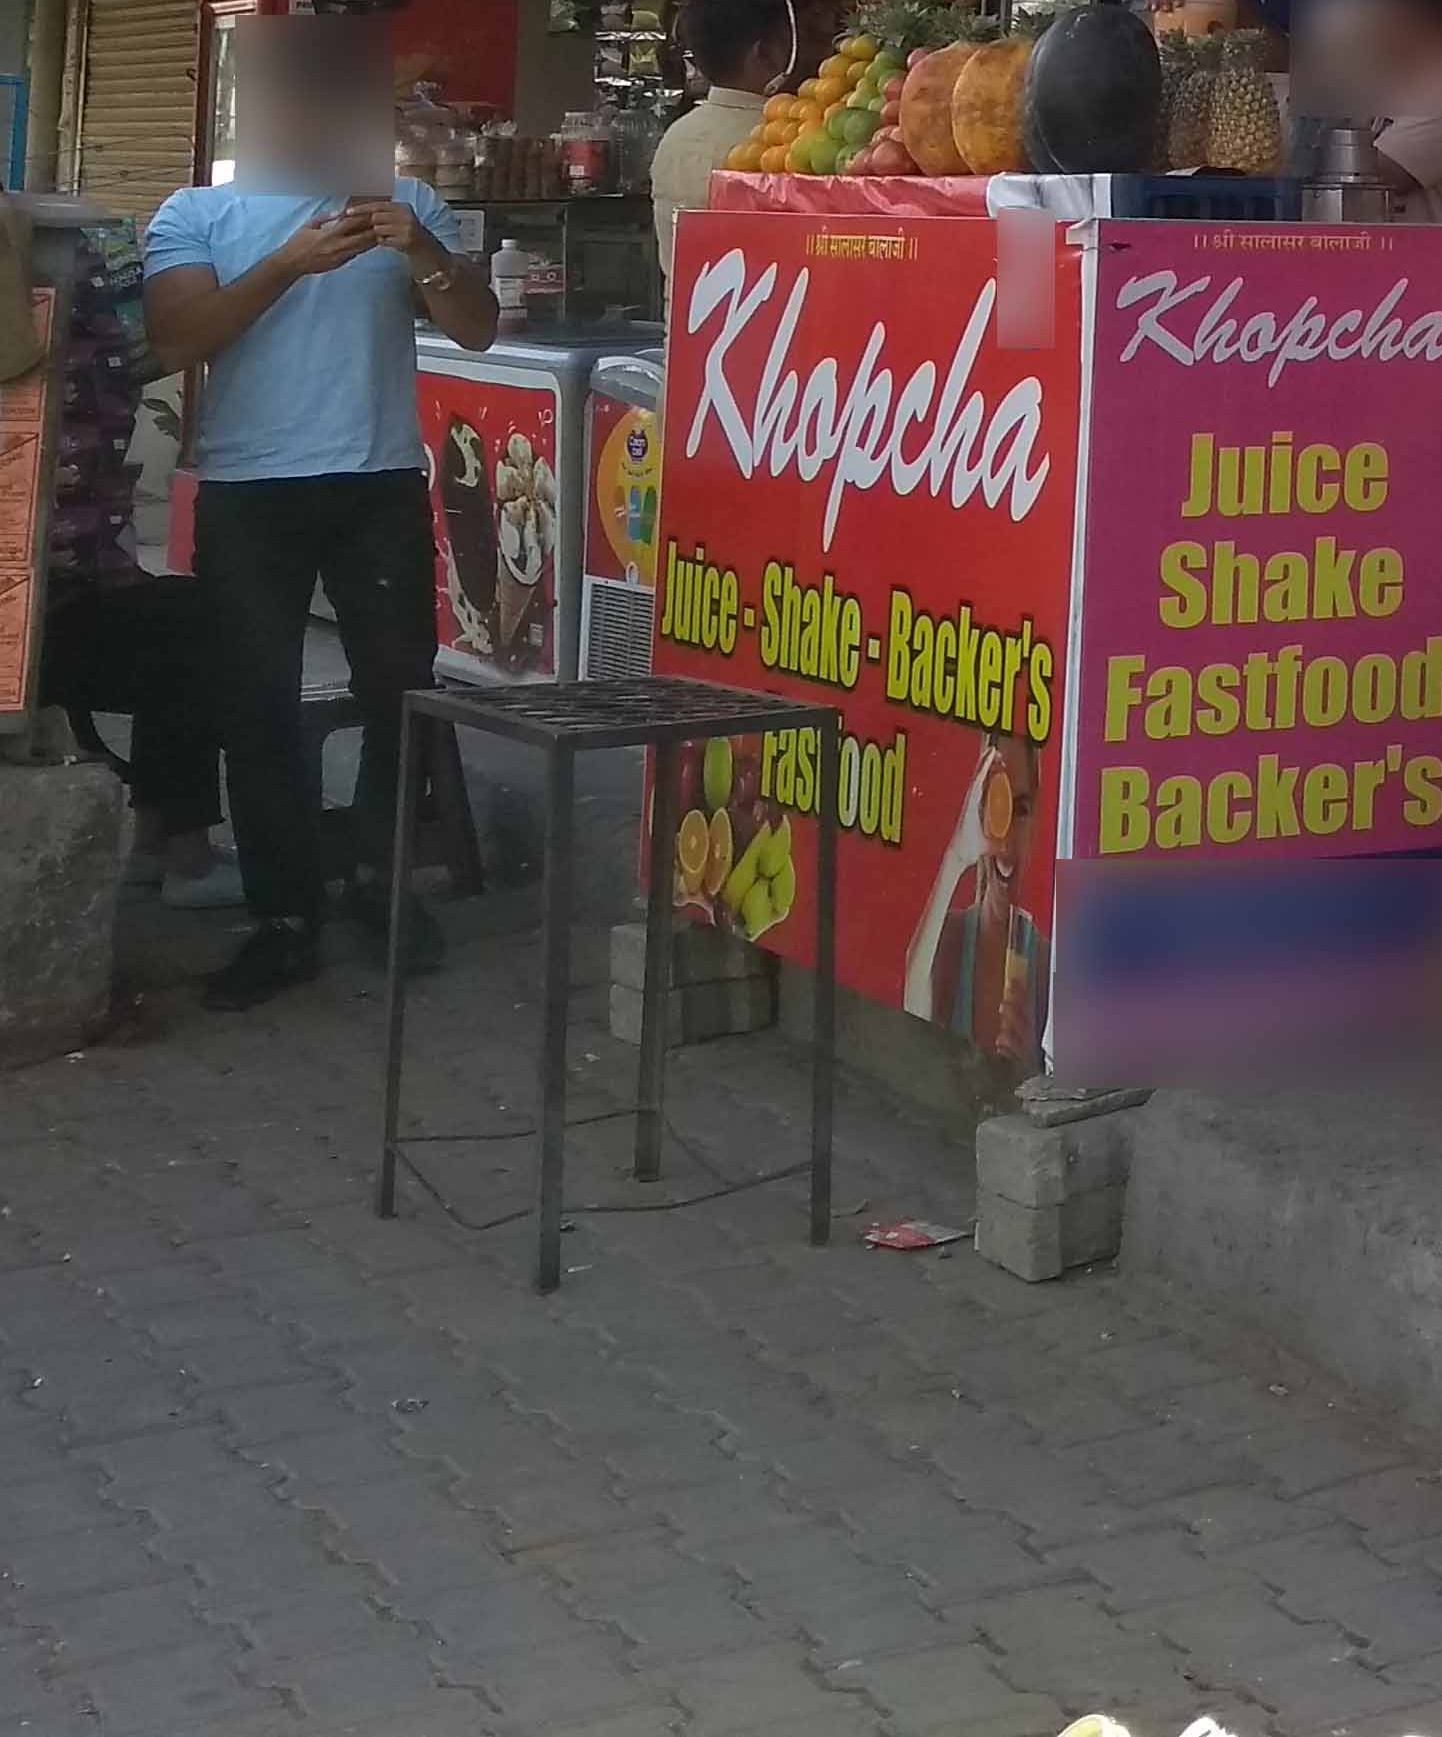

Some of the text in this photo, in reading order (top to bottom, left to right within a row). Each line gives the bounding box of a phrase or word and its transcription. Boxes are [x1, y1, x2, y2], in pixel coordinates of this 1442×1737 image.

[686, 247, 1051, 554] Khopcha
[1181, 430, 1390, 519] Juice
[660, 540, 740, 655] Juice
[760, 560, 862, 689] Shake
[886, 589, 1054, 743] Backer's
[1159, 535, 1405, 630] Shake
